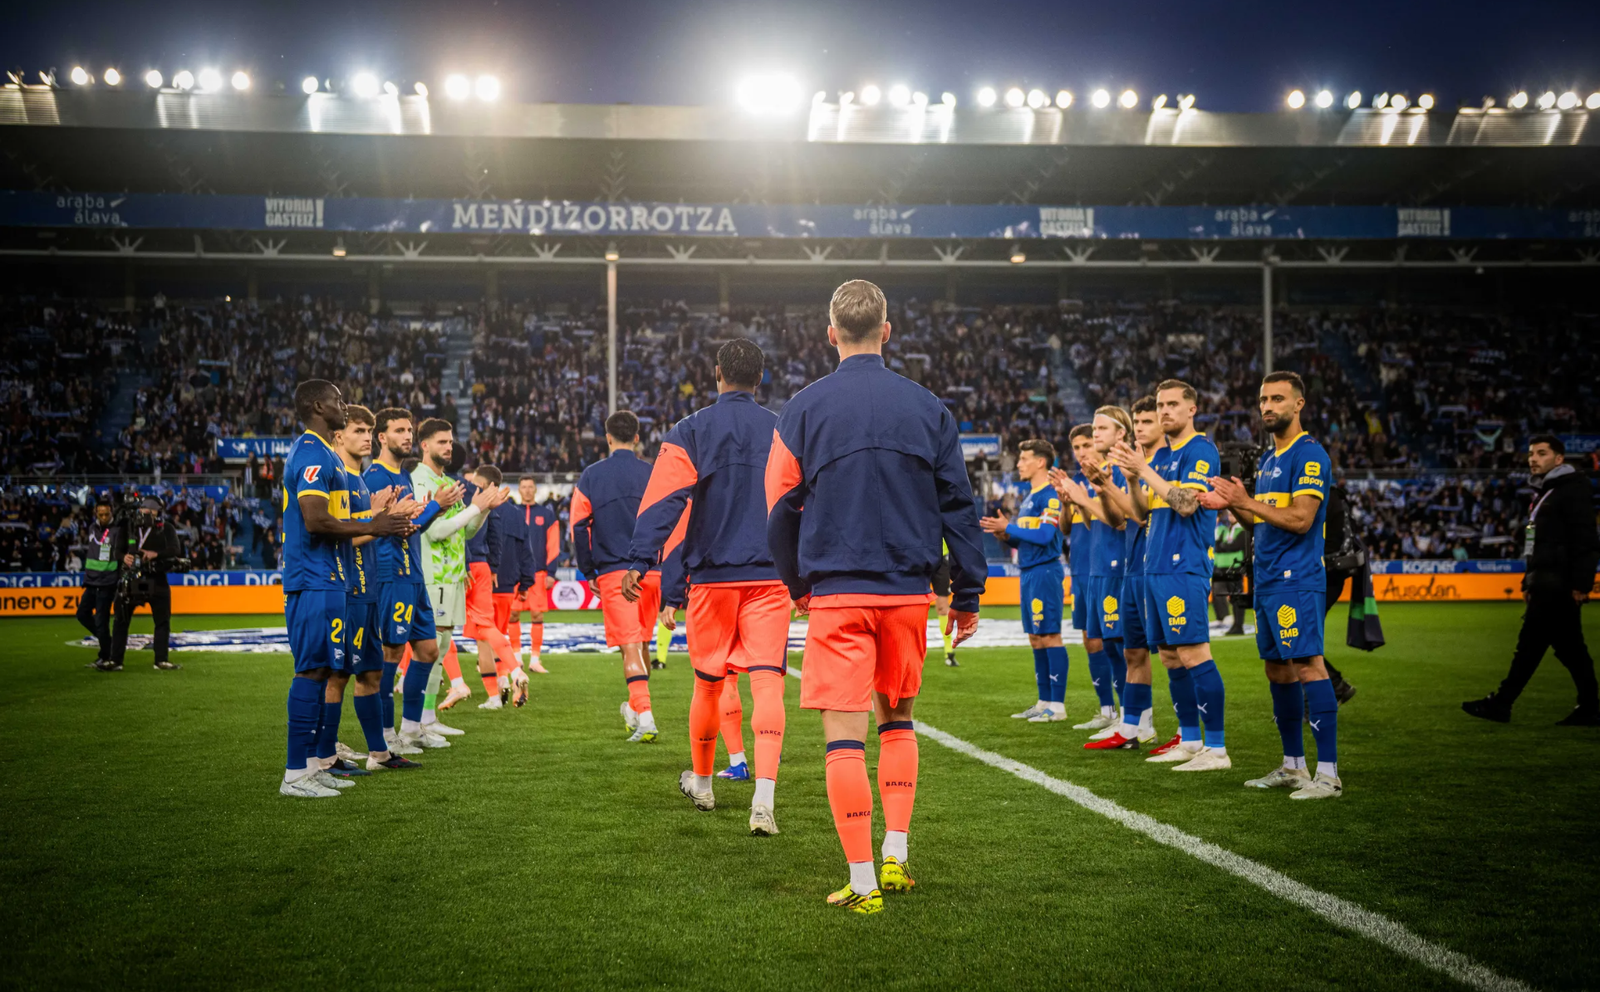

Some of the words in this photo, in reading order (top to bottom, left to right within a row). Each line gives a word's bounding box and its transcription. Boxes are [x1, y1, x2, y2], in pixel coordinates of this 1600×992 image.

[56, 193, 105, 209] araba
[265, 198, 314, 212] VITORIA
[265, 212, 314, 228] GASTEIZ
[452, 203, 737, 232] MENDIZORROTZA
[853, 205, 897, 220] araba
[1214, 207, 1258, 222] araba
[1567, 208, 1600, 223] arab
[1298, 476, 1324, 488] EBpay
[245, 573, 282, 586] DIG
[438, 587, 444, 604] 1
[392, 601, 414, 625] 24
[1168, 616, 1187, 626] EMB
[330, 617, 345, 644] 2
[352, 626, 365, 650] 4
[1279, 627, 1299, 639] EMB
